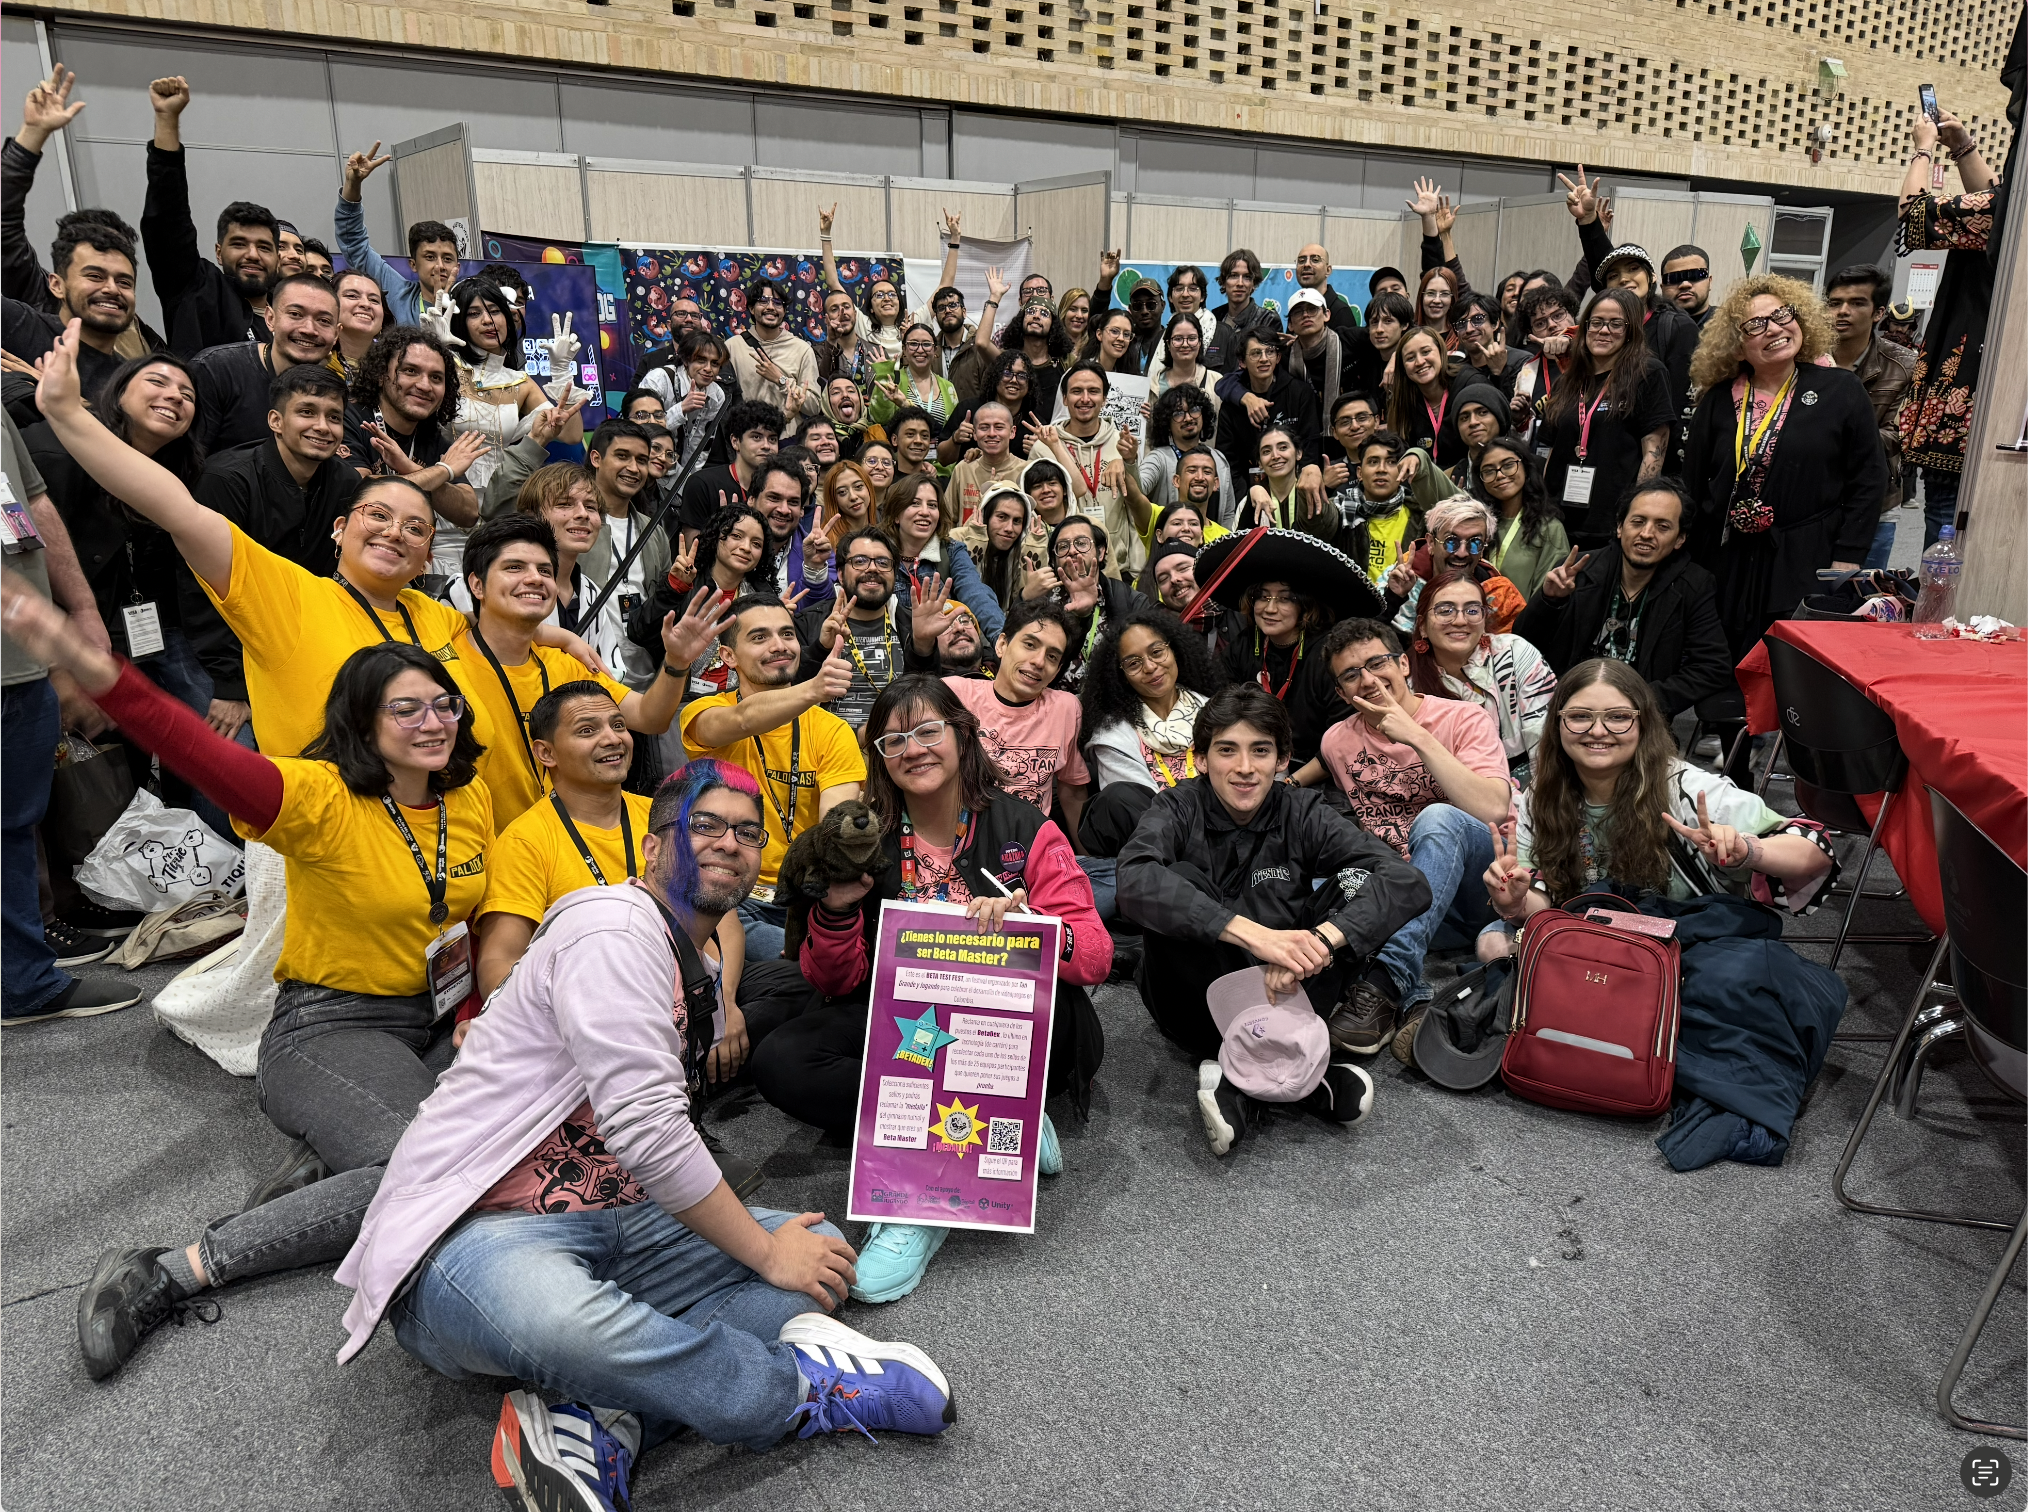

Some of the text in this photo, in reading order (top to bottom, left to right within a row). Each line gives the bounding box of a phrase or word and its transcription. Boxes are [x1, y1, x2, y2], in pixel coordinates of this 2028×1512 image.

[1030, 759, 1056, 771] TAN
[1356, 804, 1413, 818] GRANDE
[901, 931, 1040, 950] ¿Tienes lo necesario para
[917, 948, 1008, 966] ser Beta Master?
[899, 980, 915, 988] Grande
[920, 982, 940, 991] Jugando
[940, 1186, 953, 1194] apoyo
[991, 1201, 1011, 1210] Unity
